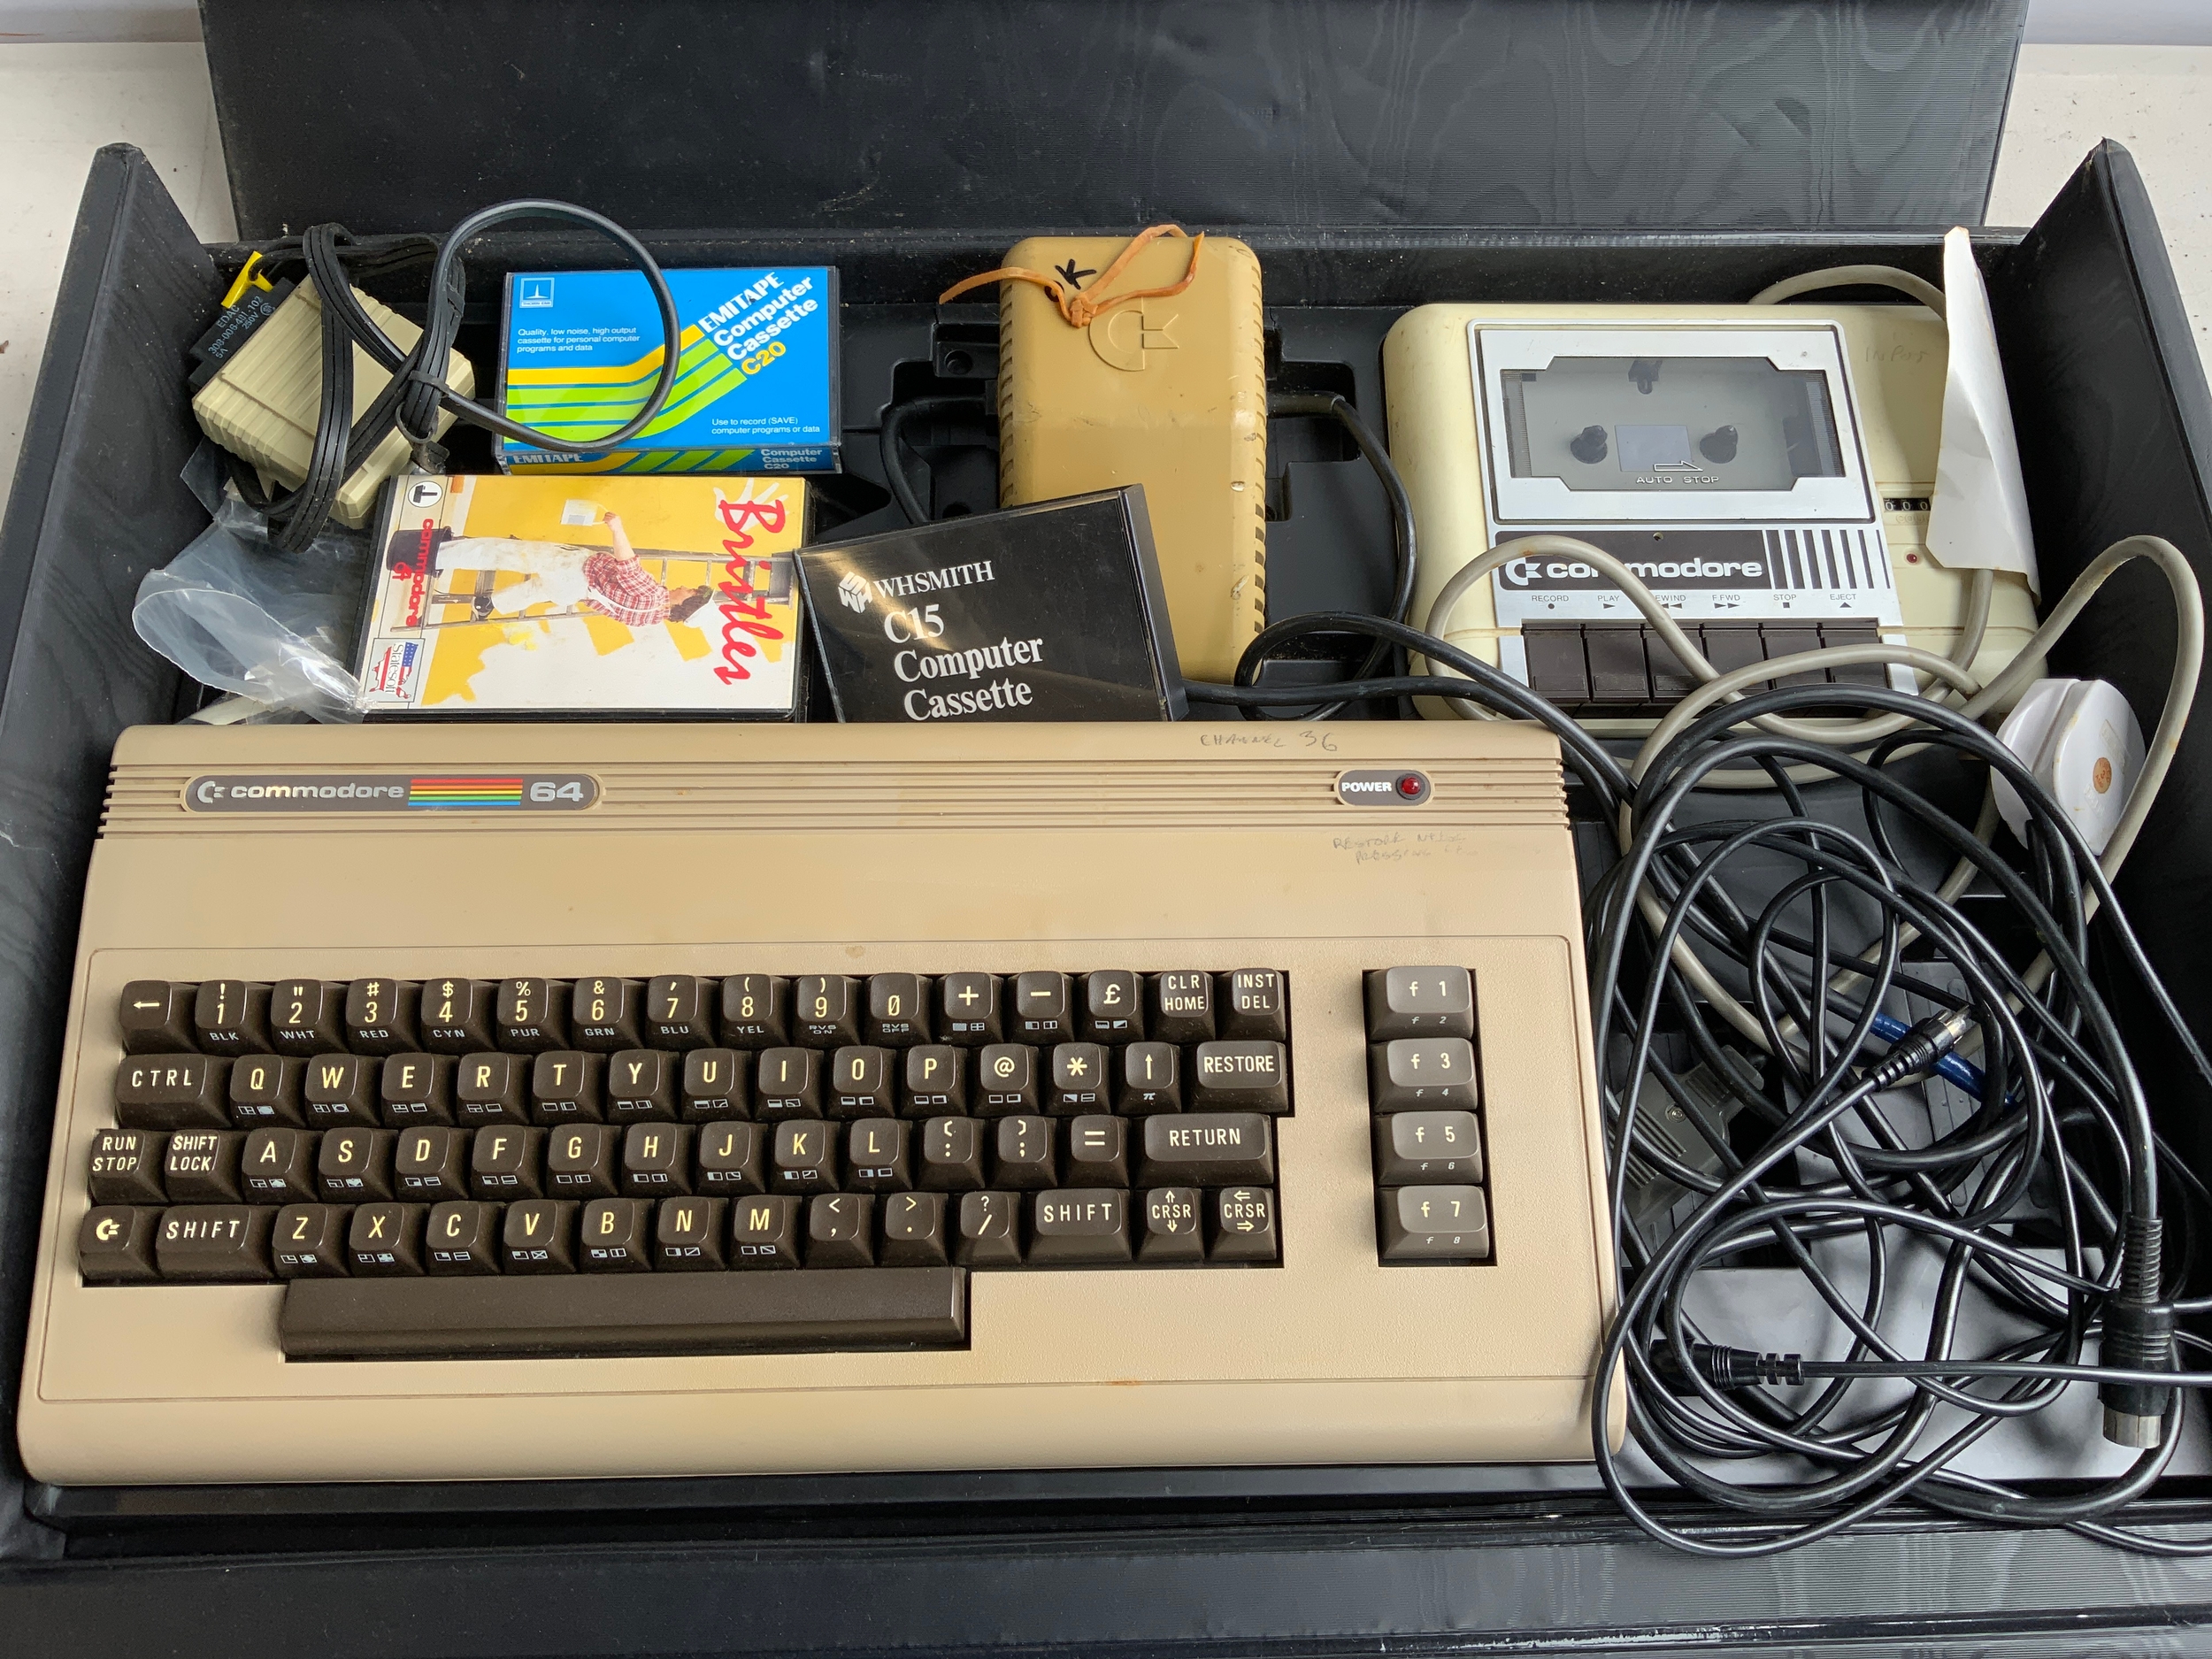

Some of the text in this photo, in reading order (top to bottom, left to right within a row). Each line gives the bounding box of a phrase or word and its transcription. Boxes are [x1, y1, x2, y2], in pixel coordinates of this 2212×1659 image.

[698, 272, 784, 333] EMITAPE
[714, 277, 813, 346] Computer
[216, 304, 239, 327] EDAC
[242, 311, 259, 329] 250V
[727, 299, 818, 360] Cassette
[517, 345, 556, 354] programs
[741, 342, 786, 374] C20
[711, 426, 750, 435] computer
[752, 426, 790, 435] programs
[405, 518, 434, 626] commodore
[873, 560, 995, 598] WHSMITH
[713, 499, 785, 686] Bristles
[885, 603, 945, 644] C15
[894, 636, 1043, 683] Computer
[904, 677, 1033, 721] Cassette
[1299, 730, 1338, 752] 36
[230, 782, 584, 802] commodore 64
[1341, 782, 1393, 792] POWER
[442, 980, 455, 998] $
[515, 980, 531, 996] %
[594, 980, 605, 995] &
[1168, 975, 1200, 989] CLR
[1238, 974, 1274, 987] INST
[1103, 983, 1121, 1005] £
[1164, 996, 1205, 1011] HOME
[1242, 995, 1271, 1010] DEL
[217, 1002, 226, 1025] 1
[288, 1002, 303, 1024] 2
[365, 1002, 378, 1023] 3
[439, 1002, 453, 1023] 4
[515, 1000, 528, 1022] 5
[591, 1000, 605, 1021] 6
[667, 997, 679, 1018] 7
[741, 996, 754, 1018] 8
[815, 996, 827, 1018] 9
[210, 1032, 239, 1041] BLK
[280, 1030, 316, 1040] WHT
[359, 1028, 389, 1039] RED
[433, 1028, 465, 1039] CYN
[510, 1028, 541, 1037] PUR
[584, 1027, 615, 1037] GRN
[660, 1025, 689, 1034] BLU
[737, 1025, 764, 1033] YEL
[553, 1064, 567, 1086] T
[628, 1063, 642, 1085] Y
[703, 1061, 717, 1083] U
[781, 1060, 787, 1082] I
[851, 1058, 864, 1079] O
[924, 1057, 938, 1079] P
[994, 1056, 1015, 1078] @
[1203, 1056, 1275, 1073] RESTORE
[131, 1069, 193, 1087] CTRL
[250, 1069, 265, 1091] Q
[321, 1066, 344, 1088] W
[402, 1066, 416, 1088] E
[476, 1065, 491, 1087] R
[102, 1136, 136, 1150] RUN
[172, 1136, 217, 1150] SHIFT
[567, 1137, 582, 1158] G
[643, 1136, 658, 1158] H
[718, 1134, 733, 1156] J
[792, 1133, 808, 1156] K
[868, 1131, 880, 1153] L
[1169, 1128, 1240, 1147] RETURN
[260, 1141, 276, 1163] A
[337, 1141, 354, 1163] S
[416, 1139, 431, 1161] D
[492, 1138, 508, 1160] F
[92, 1157, 137, 1171] STOP
[170, 1156, 211, 1171] LOCK
[675, 1210, 692, 1232] N
[749, 1208, 770, 1230] M
[1043, 1203, 1112, 1223] SHIFT
[1152, 1204, 1191, 1219] CRSR
[1224, 1204, 1265, 1218] CRSR
[166, 1219, 240, 1239] SHIFT
[292, 1217, 309, 1239] Z
[368, 1216, 386, 1238] X
[446, 1214, 461, 1237] C
[525, 1213, 540, 1235] V
[600, 1211, 614, 1234] B
